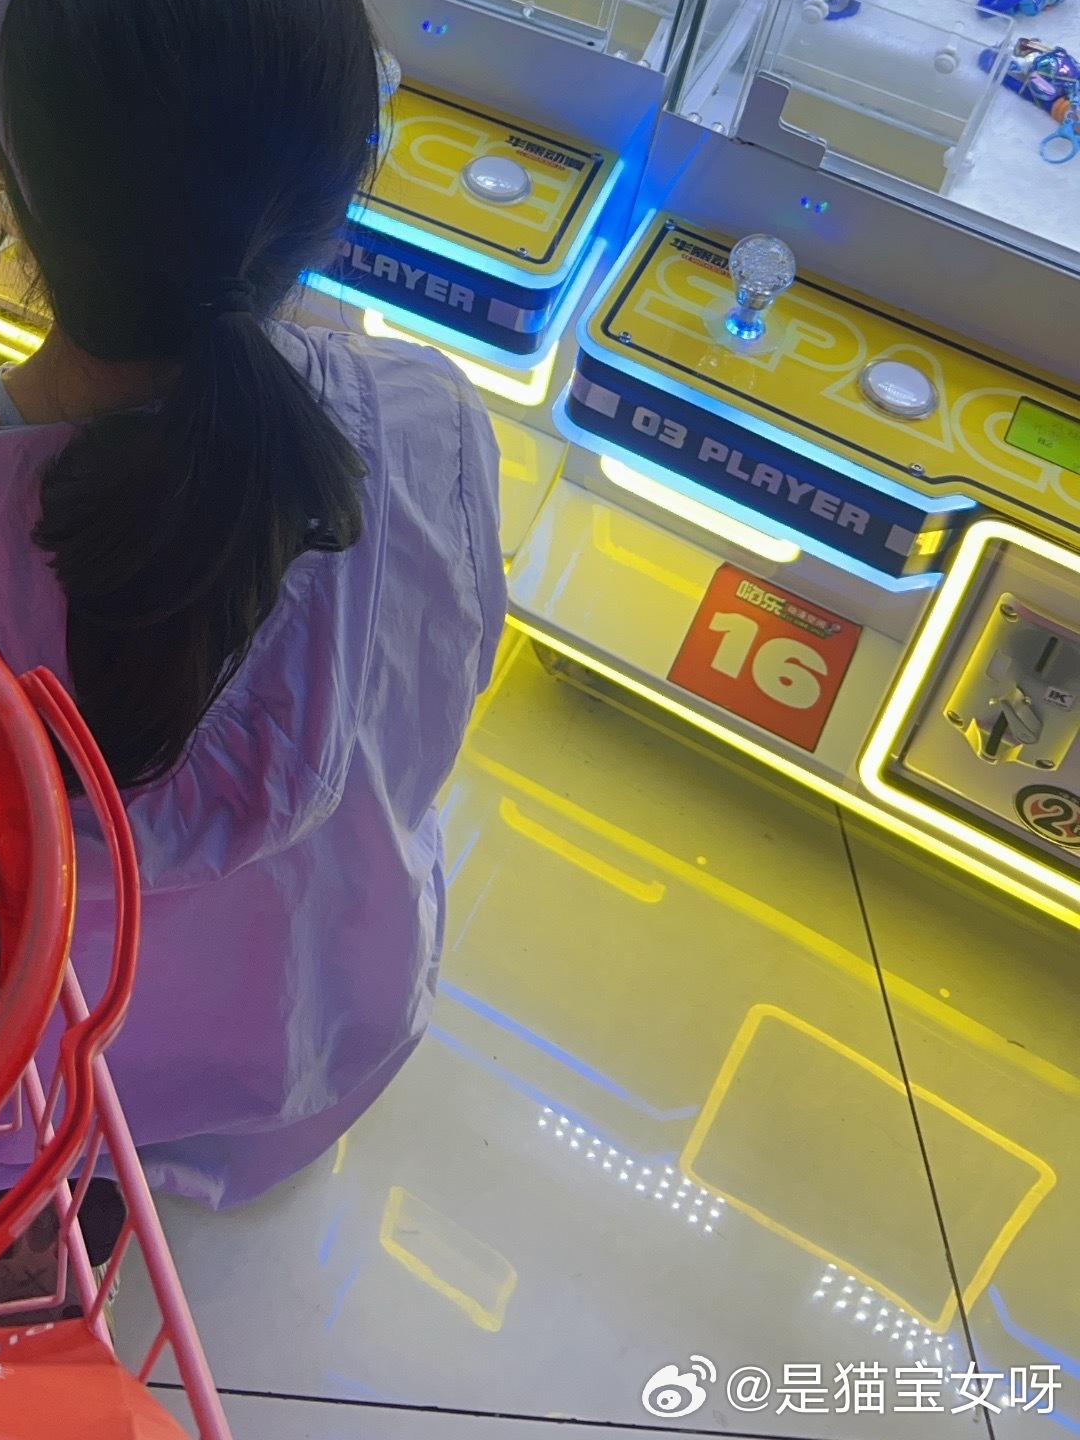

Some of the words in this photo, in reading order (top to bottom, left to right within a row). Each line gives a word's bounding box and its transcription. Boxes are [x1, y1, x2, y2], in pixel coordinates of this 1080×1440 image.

[631, 406, 688, 449] 03
[698, 436, 873, 536] PLAYER
[708, 611, 829, 709] 16
